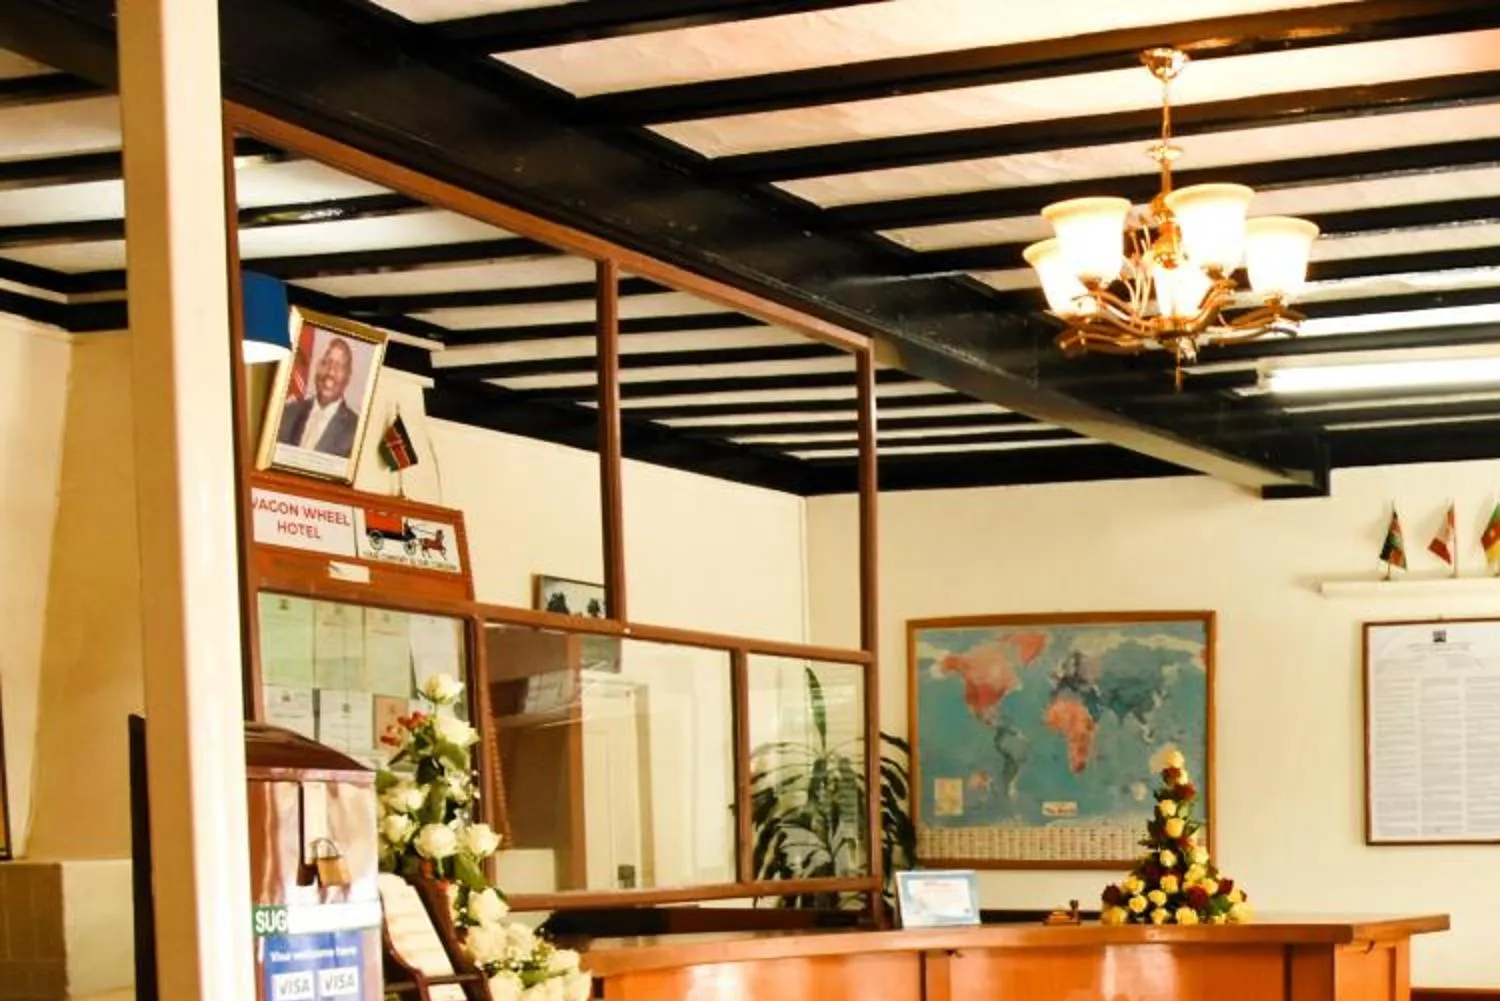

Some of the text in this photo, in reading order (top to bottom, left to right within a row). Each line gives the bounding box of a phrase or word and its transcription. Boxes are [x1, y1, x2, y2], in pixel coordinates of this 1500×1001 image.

[302, 507, 351, 526] WHEEL
[277, 520, 321, 539] HOTEL
[279, 973, 356, 995] VISA VISA
